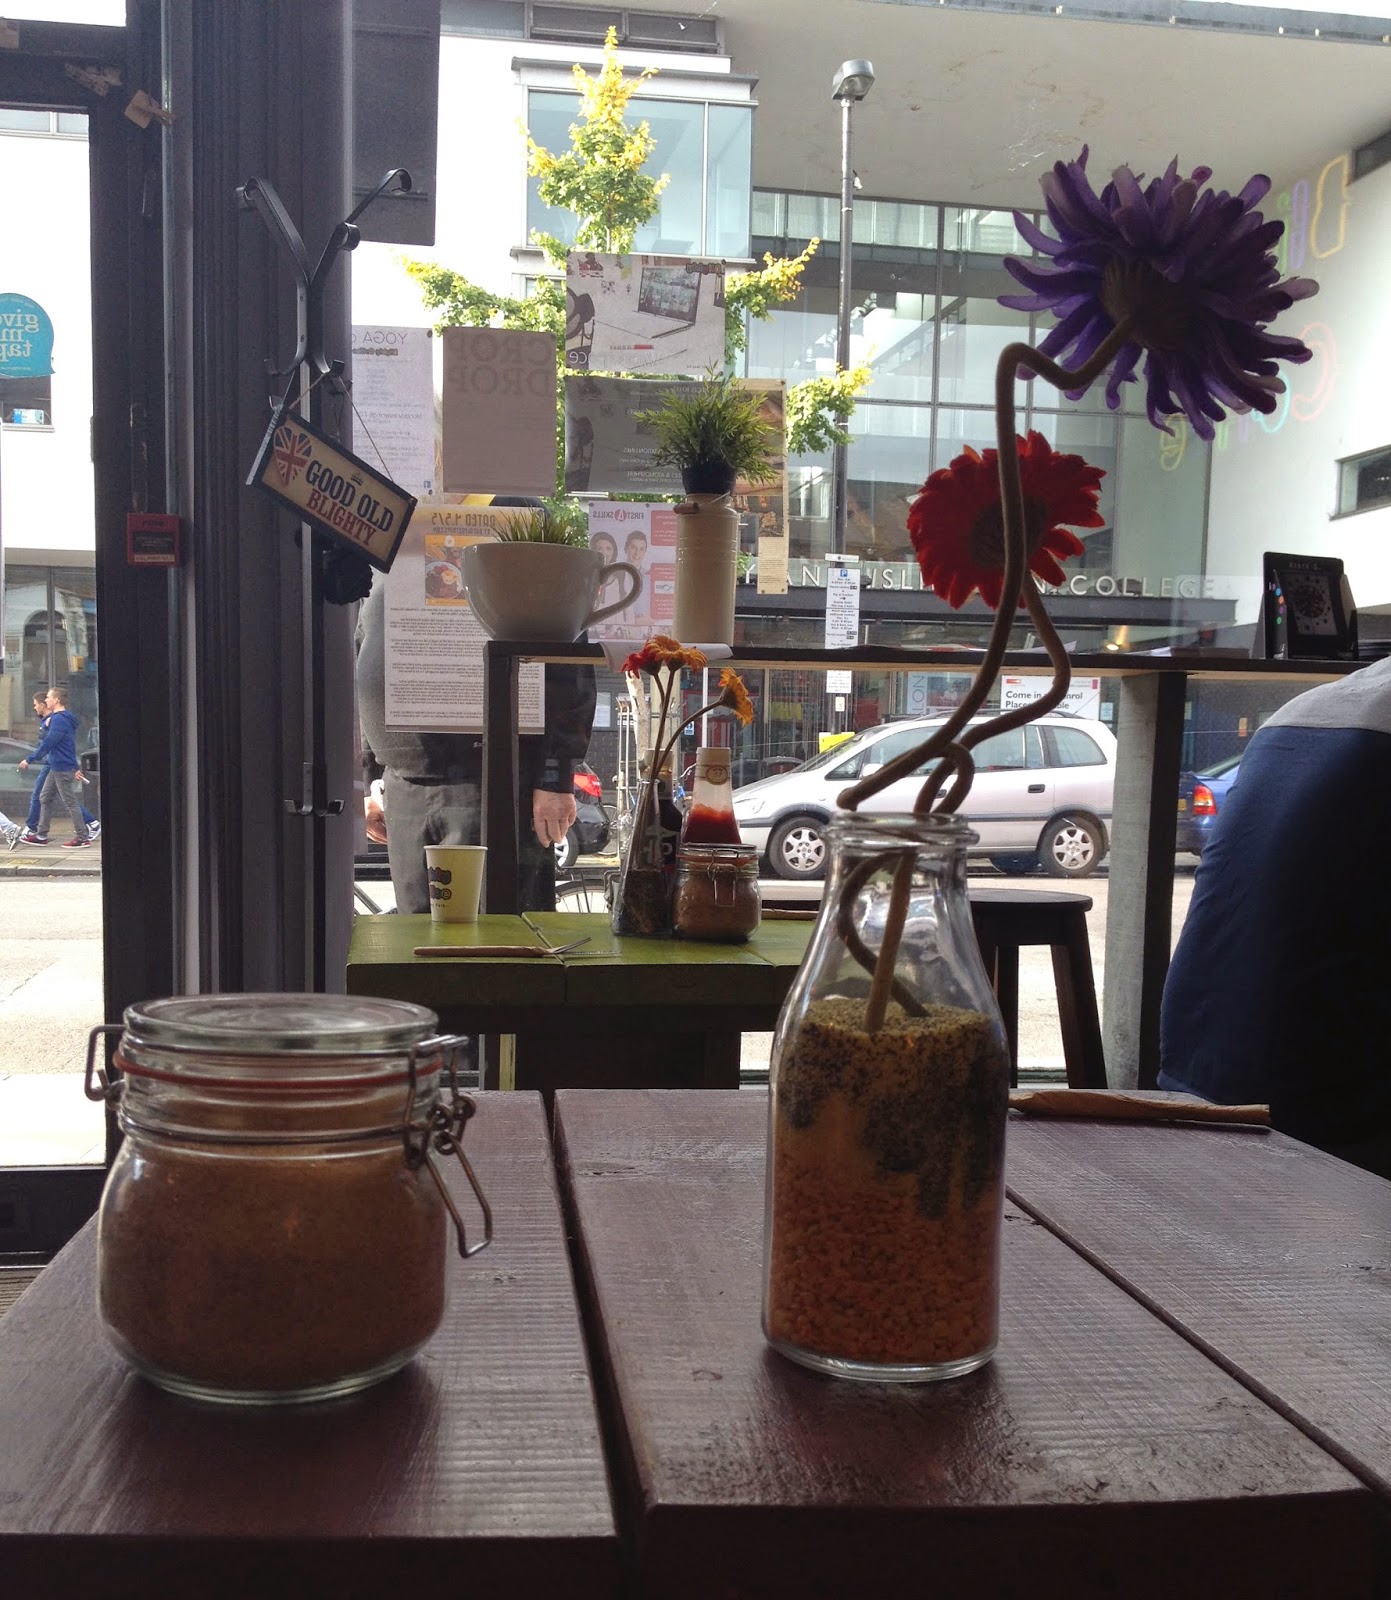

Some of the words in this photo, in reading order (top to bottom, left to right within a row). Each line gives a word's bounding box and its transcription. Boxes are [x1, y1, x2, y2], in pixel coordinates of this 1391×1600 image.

[306, 460, 356, 507] GOOD
[357, 493, 394, 532] OLD
[307, 488, 377, 546] BLIGHTY
[1069, 574, 1216, 599] COLLEGE
[1005, 690, 1032, 699] Come
[1034, 691, 1042, 699] in
[1065, 692, 1083, 700] nrol
[1005, 702, 1030, 711] Place
